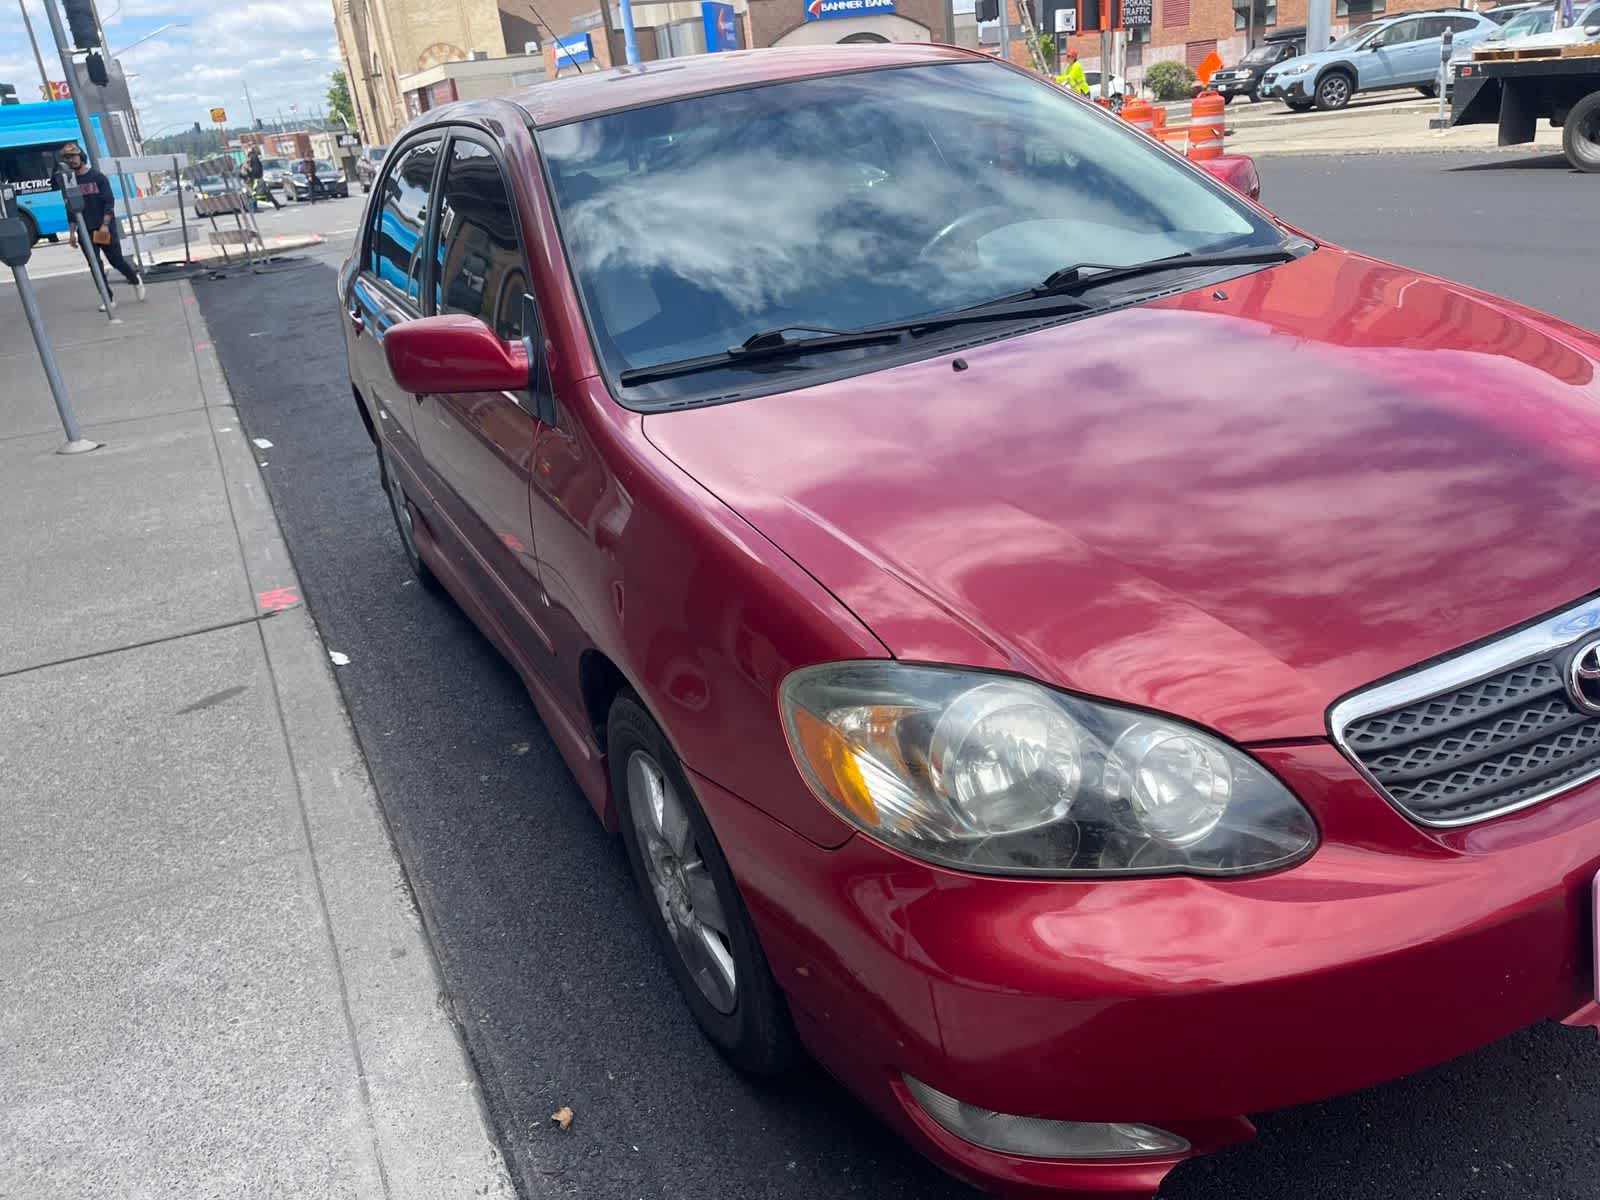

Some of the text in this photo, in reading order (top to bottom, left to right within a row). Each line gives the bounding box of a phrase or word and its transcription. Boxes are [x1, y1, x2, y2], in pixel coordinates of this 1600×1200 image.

[821, 0, 894, 12] BANNER BANK
[1121, 7, 1151, 16] TRAFFIC
[1121, 15, 1152, 25] CONTROL
